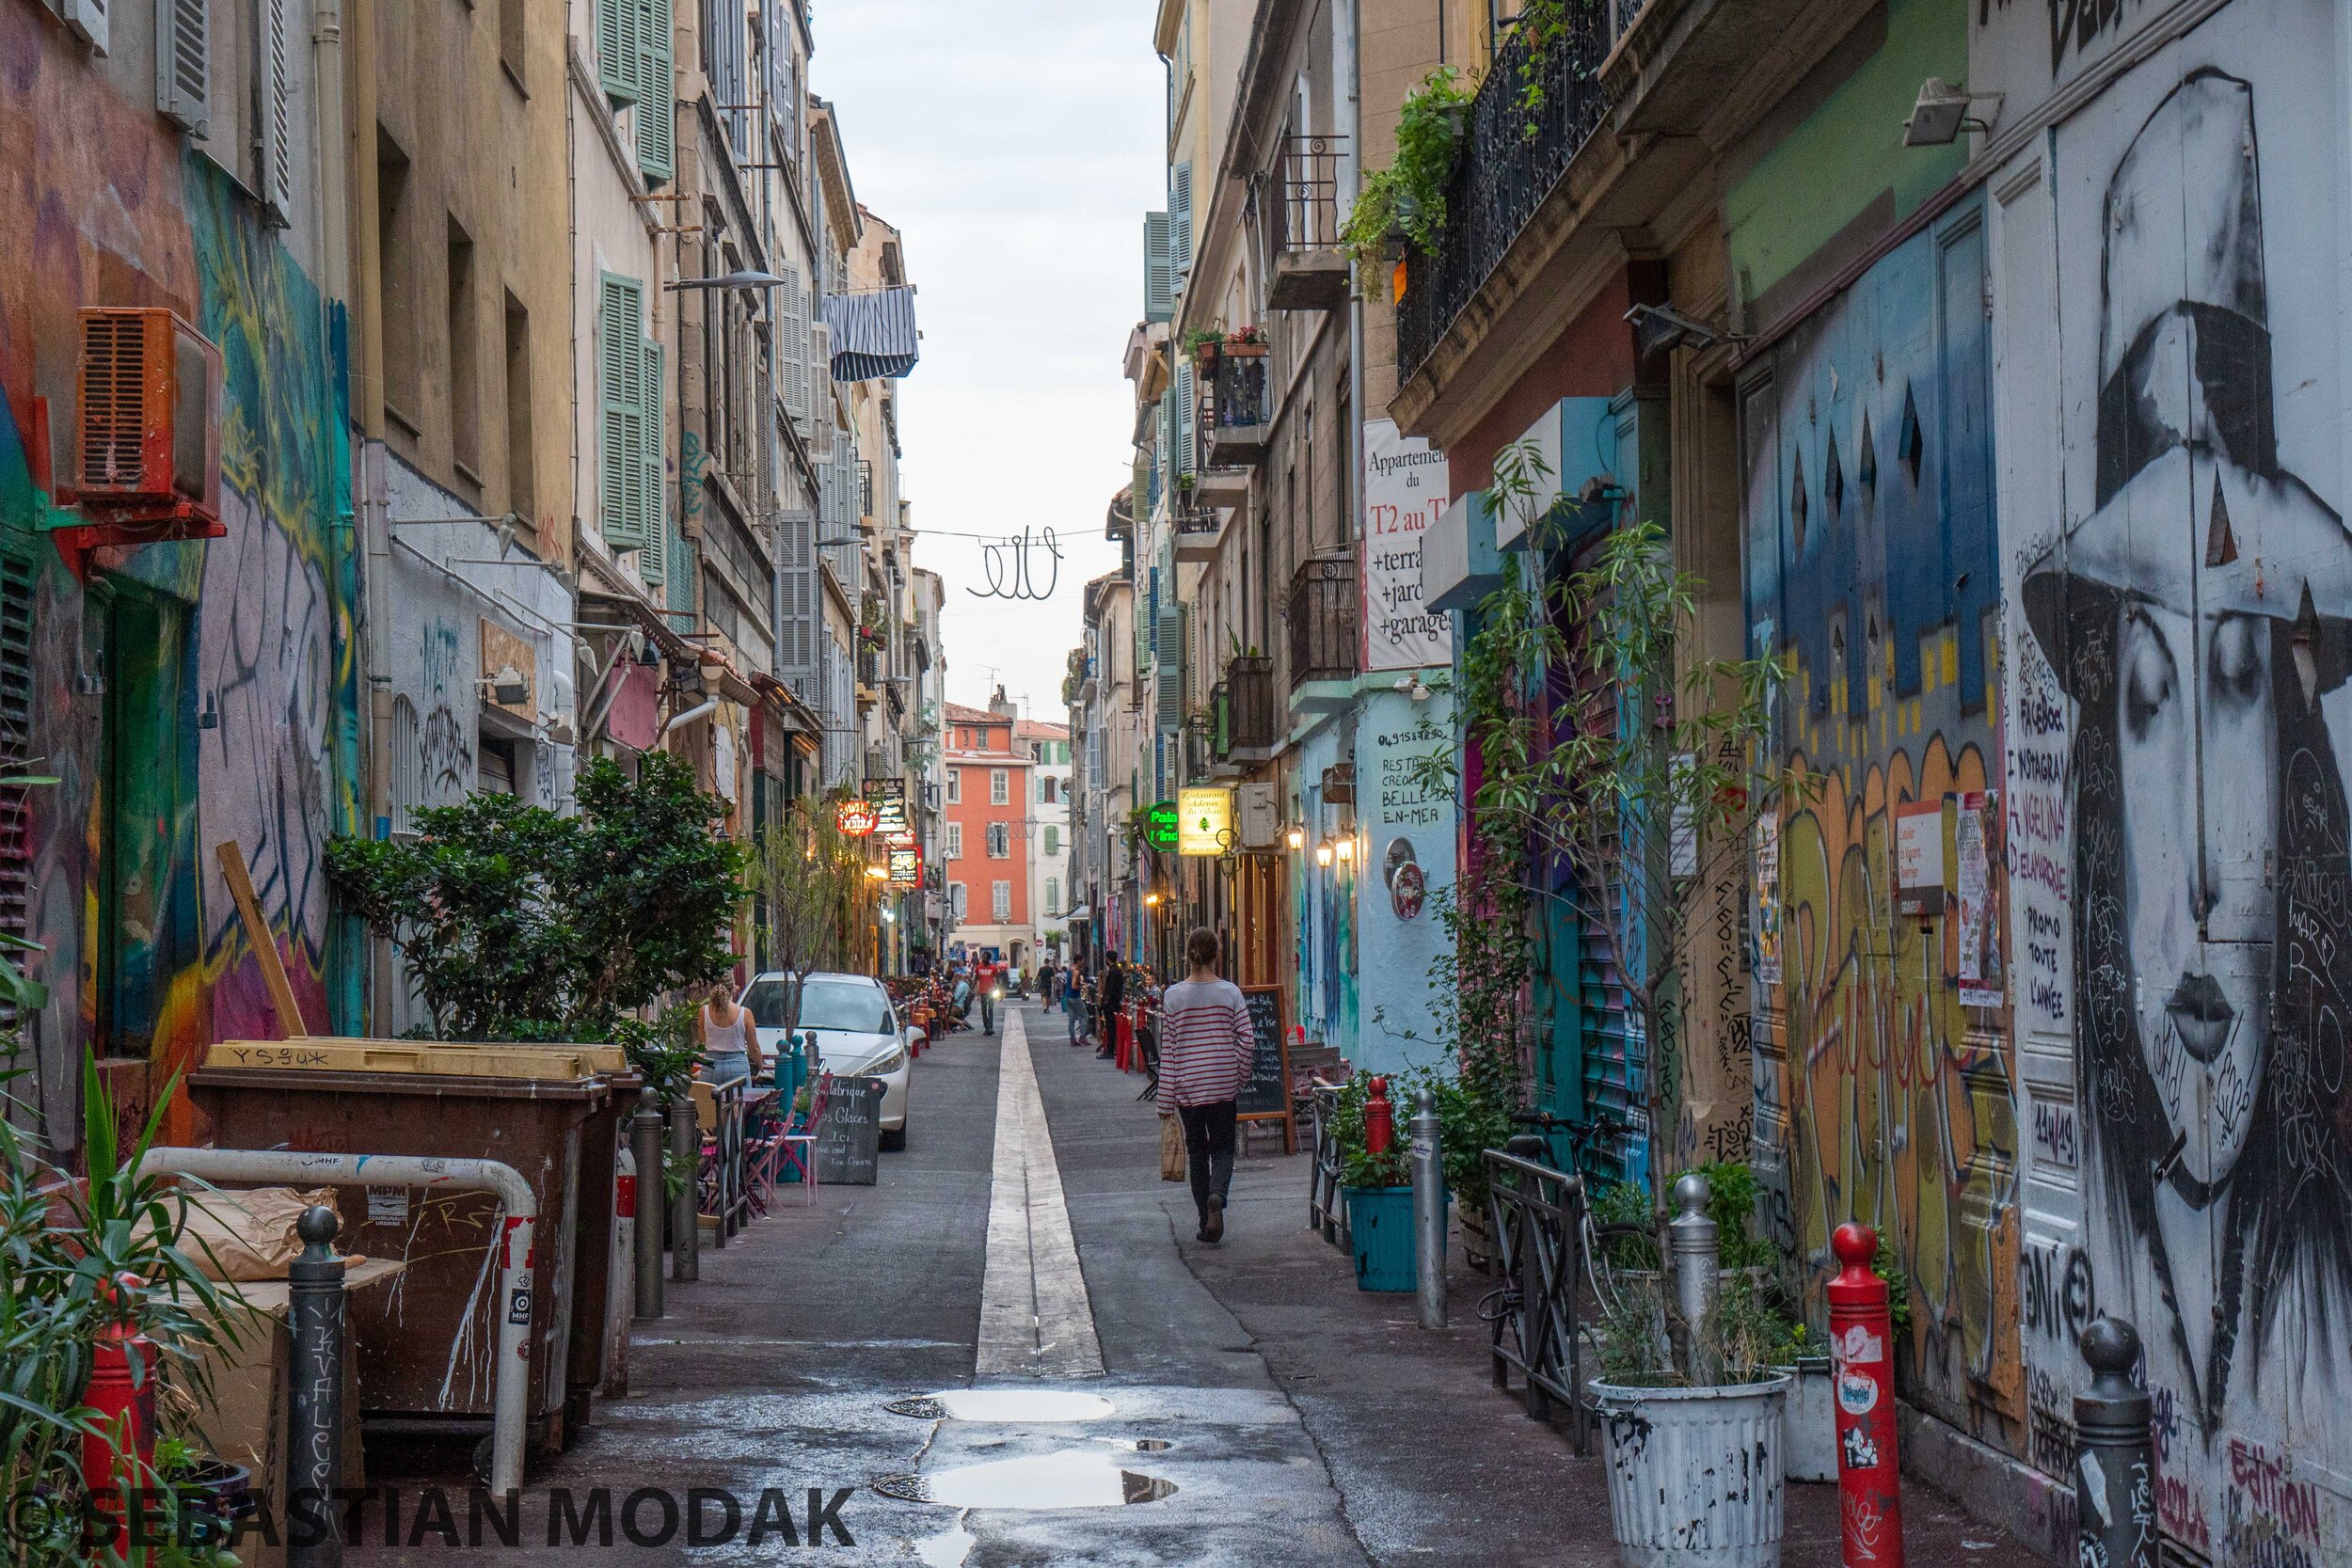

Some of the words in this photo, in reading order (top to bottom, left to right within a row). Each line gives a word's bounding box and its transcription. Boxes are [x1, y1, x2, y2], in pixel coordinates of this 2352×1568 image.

[1369, 450, 1447, 476] Appartemen
[1406, 471, 1420, 487] du
[1371, 504, 1399, 535] T2
[1404, 511, 1426, 531] au
[1427, 497, 1447, 523] T
[1373, 548, 1422, 572] +terra
[1382, 572, 1423, 612] +jard
[1182, 791, 1226, 801] Restaurant
[1382, 789, 1427, 807] BELLE
[1150, 810, 1178, 823] Pala
[1383, 808, 1438, 827] EN-MER
[1150, 830, 1178, 842] l'Ind
[2026, 907, 2060, 939] PROMO
[2028, 942, 2058, 974] TOUTE
[834, 1106, 868, 1124] Glaces
[848, 1156, 873, 1166] Cream
[512, 1311, 530, 1321] MHF
